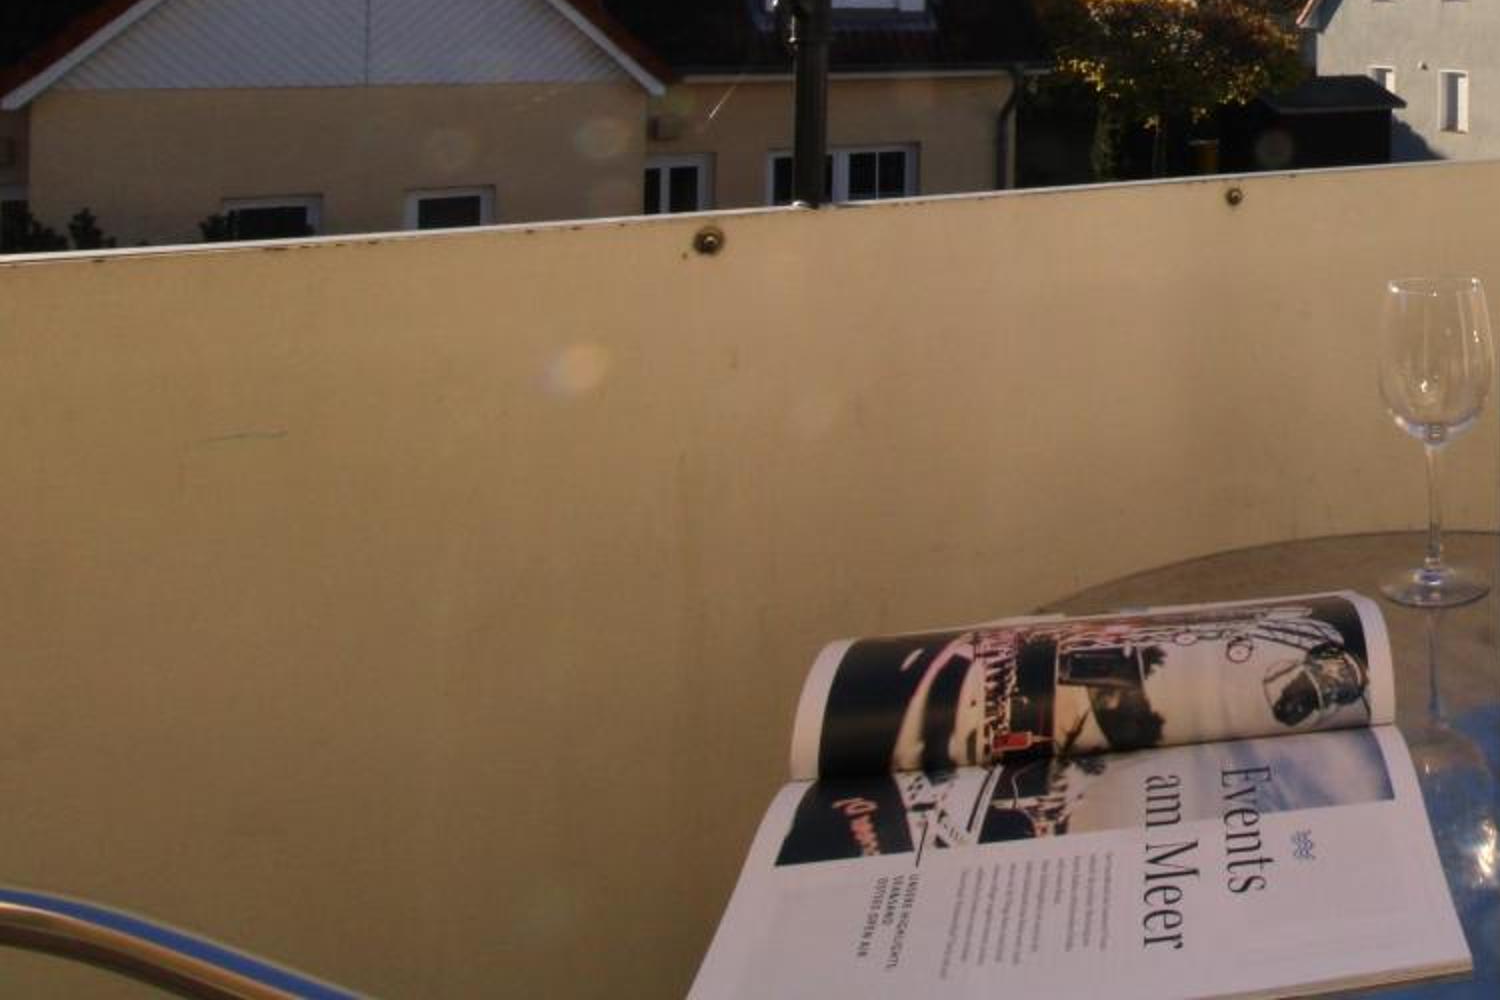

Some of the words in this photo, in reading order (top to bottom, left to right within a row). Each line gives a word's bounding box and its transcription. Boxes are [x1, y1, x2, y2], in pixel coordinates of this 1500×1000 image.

[1144, 774, 1182, 830] am
[1221, 765, 1274, 894] Events
[1142, 839, 1200, 950] Meer
